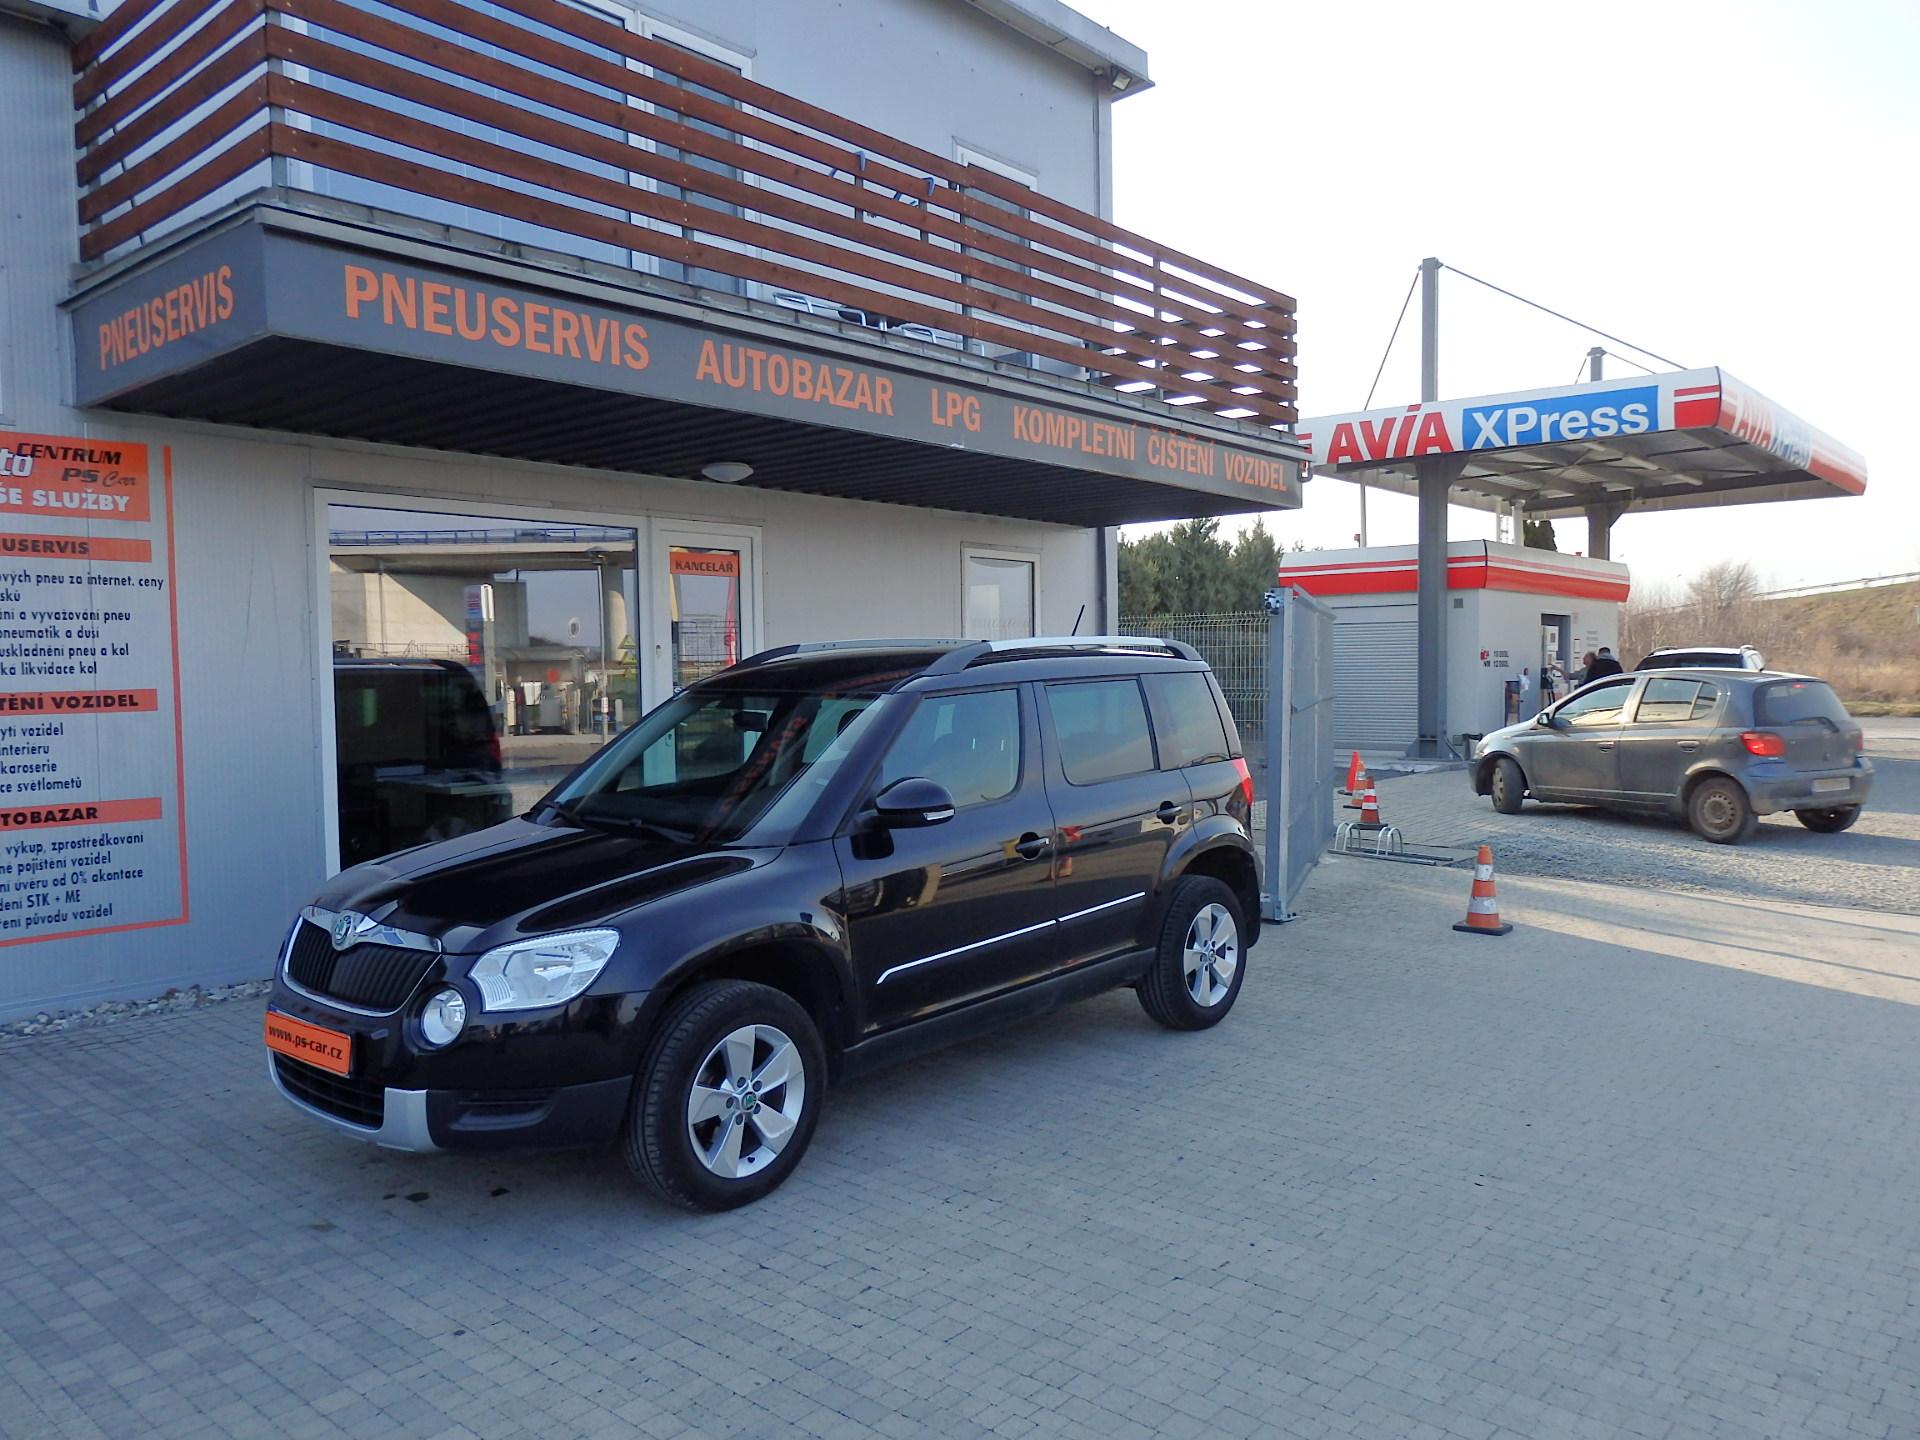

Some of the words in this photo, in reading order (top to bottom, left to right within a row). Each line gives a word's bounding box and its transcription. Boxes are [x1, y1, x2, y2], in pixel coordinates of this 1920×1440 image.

[100, 265, 234, 371] PNEUSERVIS
[344, 264, 649, 371] PNEUSERVIS
[696, 340, 894, 416] AUTOBAZAR
[931, 388, 981, 432] LPG
[1013, 405, 1136, 460] KOMPLETNÍ
[1148, 427, 1214, 476] ČIŠTĚNÍ
[1224, 453, 1287, 491] VOZIDEL
[1471, 402, 1650, 450] XPress
[16, 442, 122, 465] CENTRUM
[61, 468, 100, 484] PS
[32, 488, 130, 512] SLUŽBY
[2, 538, 90, 555] USERVIS
[36, 573, 65, 587] pneu
[69, 575, 83, 585] za
[88, 571, 135, 587] internet.
[138, 577, 164, 590] ceny
[19, 612, 26, 621] a
[104, 612, 131, 624] pneu
[65, 630, 72, 639] a
[68, 646, 96, 659] pneu
[100, 648, 107, 656] a
[112, 643, 129, 656] kol
[21, 662, 75, 675] likvidace
[80, 661, 97, 674] kol
[51, 694, 139, 709] VOZIDEL
[21, 723, 64, 737] vozidel
[0, 760, 57, 774] karoserie
[0, 807, 98, 827] TOBAZAR
[71, 851, 111, 867] vozidel
[52, 875, 66, 887] od
[71, 871, 87, 885] 0%
[92, 869, 143, 884] akontace
[27, 893, 51, 908] STK
[65, 890, 81, 904] ME
[26, 909, 68, 929] původu
[72, 903, 113, 920] vozidel
[268, 1025, 343, 1060] www.ps-car.cz
